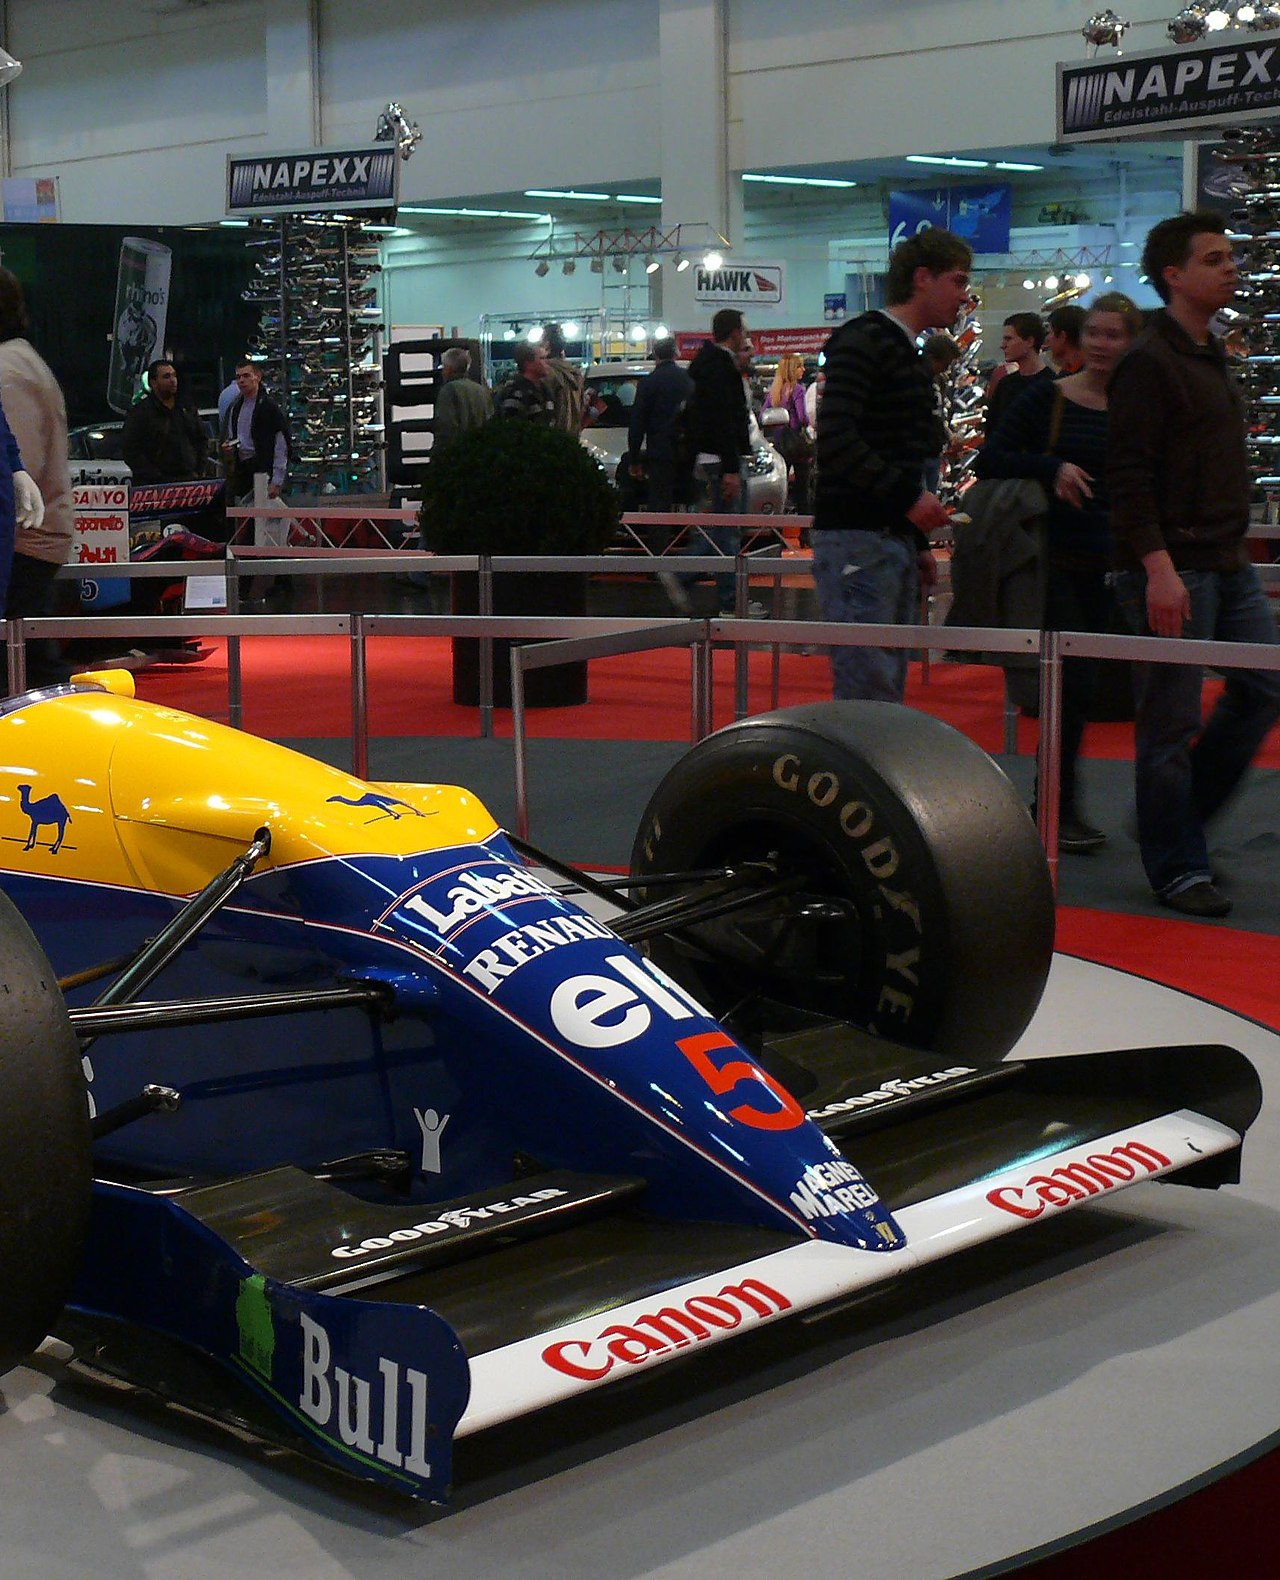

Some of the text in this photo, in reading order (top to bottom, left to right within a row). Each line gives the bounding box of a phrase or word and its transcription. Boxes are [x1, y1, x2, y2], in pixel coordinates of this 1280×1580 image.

[1103, 47, 1280, 106] NAPEX
[1104, 87, 1280, 123] Edelstahl-Auspuff-Tech
[253, 156, 370, 190] NAPEXX
[697, 270, 752, 292] HAWK
[80, 578, 100, 601] 5
[772, 753, 921, 1026] GOODYE
[463, 915, 625, 996] RENAU
[674, 1031, 805, 1131] 5
[811, 1065, 979, 1119] GOODYEAR
[986, 1141, 1172, 1220] Canon
[331, 1187, 569, 1259] GOODYEAR
[541, 1276, 792, 1382] Canon
[299, 1311, 431, 1479] Bull
